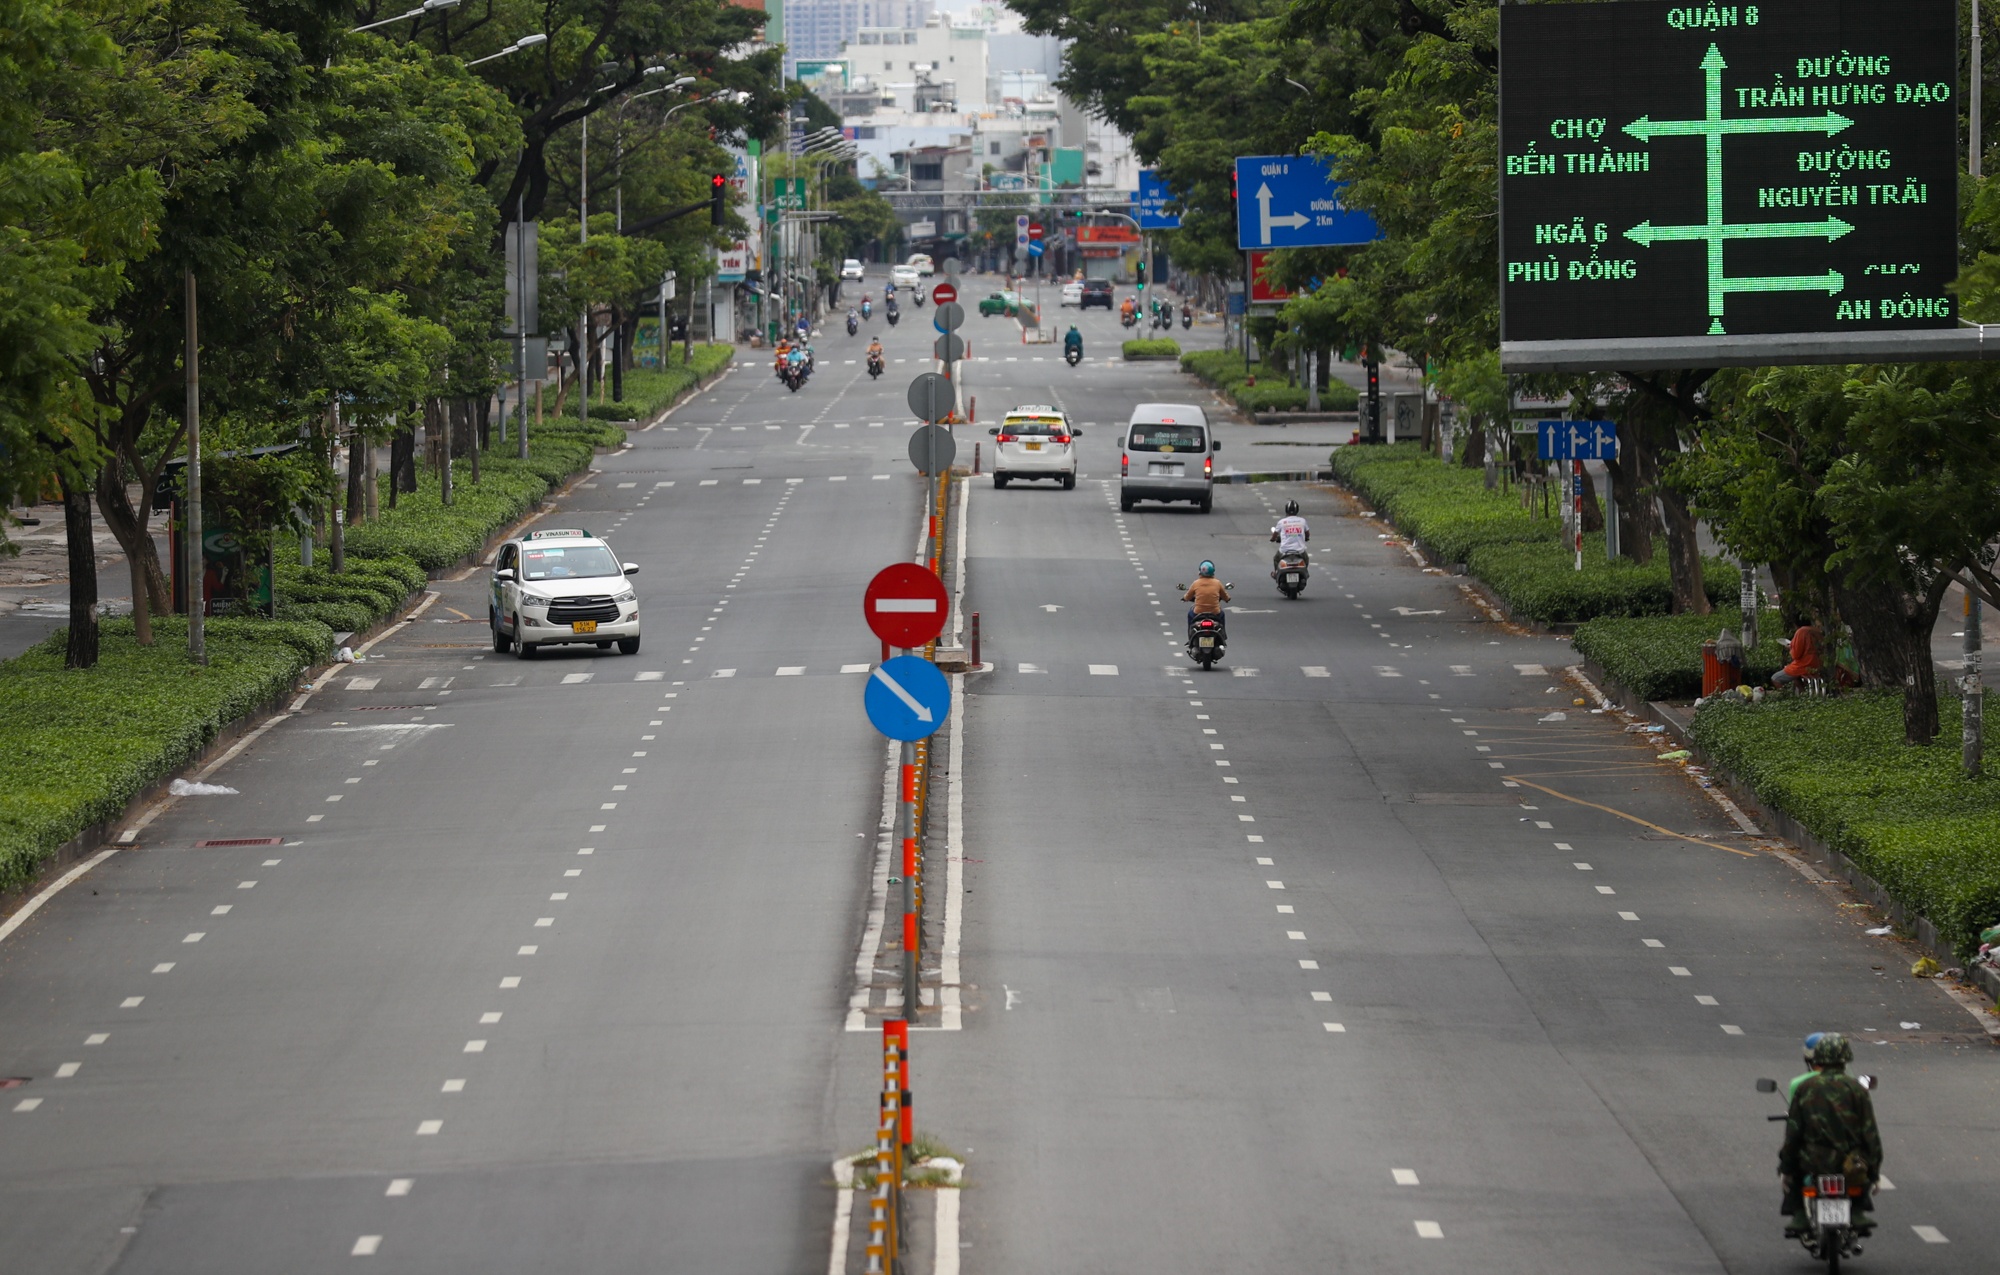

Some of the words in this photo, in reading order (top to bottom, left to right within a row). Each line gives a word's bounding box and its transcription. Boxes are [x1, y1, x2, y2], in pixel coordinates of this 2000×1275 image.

[1667, 1, 1738, 31] QUẬN
[1745, 6, 1759, 26] 8
[1797, 50, 1890, 78] ĐƯỜNG
[1735, 73, 1805, 108] TRẦN
[1812, 84, 1886, 106] HƯNG
[1894, 82, 1951, 107] ĐẠO
[1550, 118, 1607, 143] CHỢ
[1261, 162, 1282, 178] QUẬN
[1283, 164, 1289, 175] 8
[1506, 141, 1556, 175] BẾN
[1563, 146, 1649, 173] THÀNH
[1797, 144, 1891, 172] ĐƯỜNG
[1758, 172, 1858, 208] NGUYỄN
[1866, 177, 1928, 205] TRÃI
[1316, 217, 1321, 227] 2
[1321, 215, 1333, 226] Km
[1535, 216, 1587, 244] NGÃ
[1594, 223, 1608, 242] 6
[1508, 254, 1559, 282] PHÙ
[1567, 244, 1637, 280] ĐỔNG
[1836, 300, 1871, 320] AN
[1879, 291, 1950, 319] ĐÔNG
